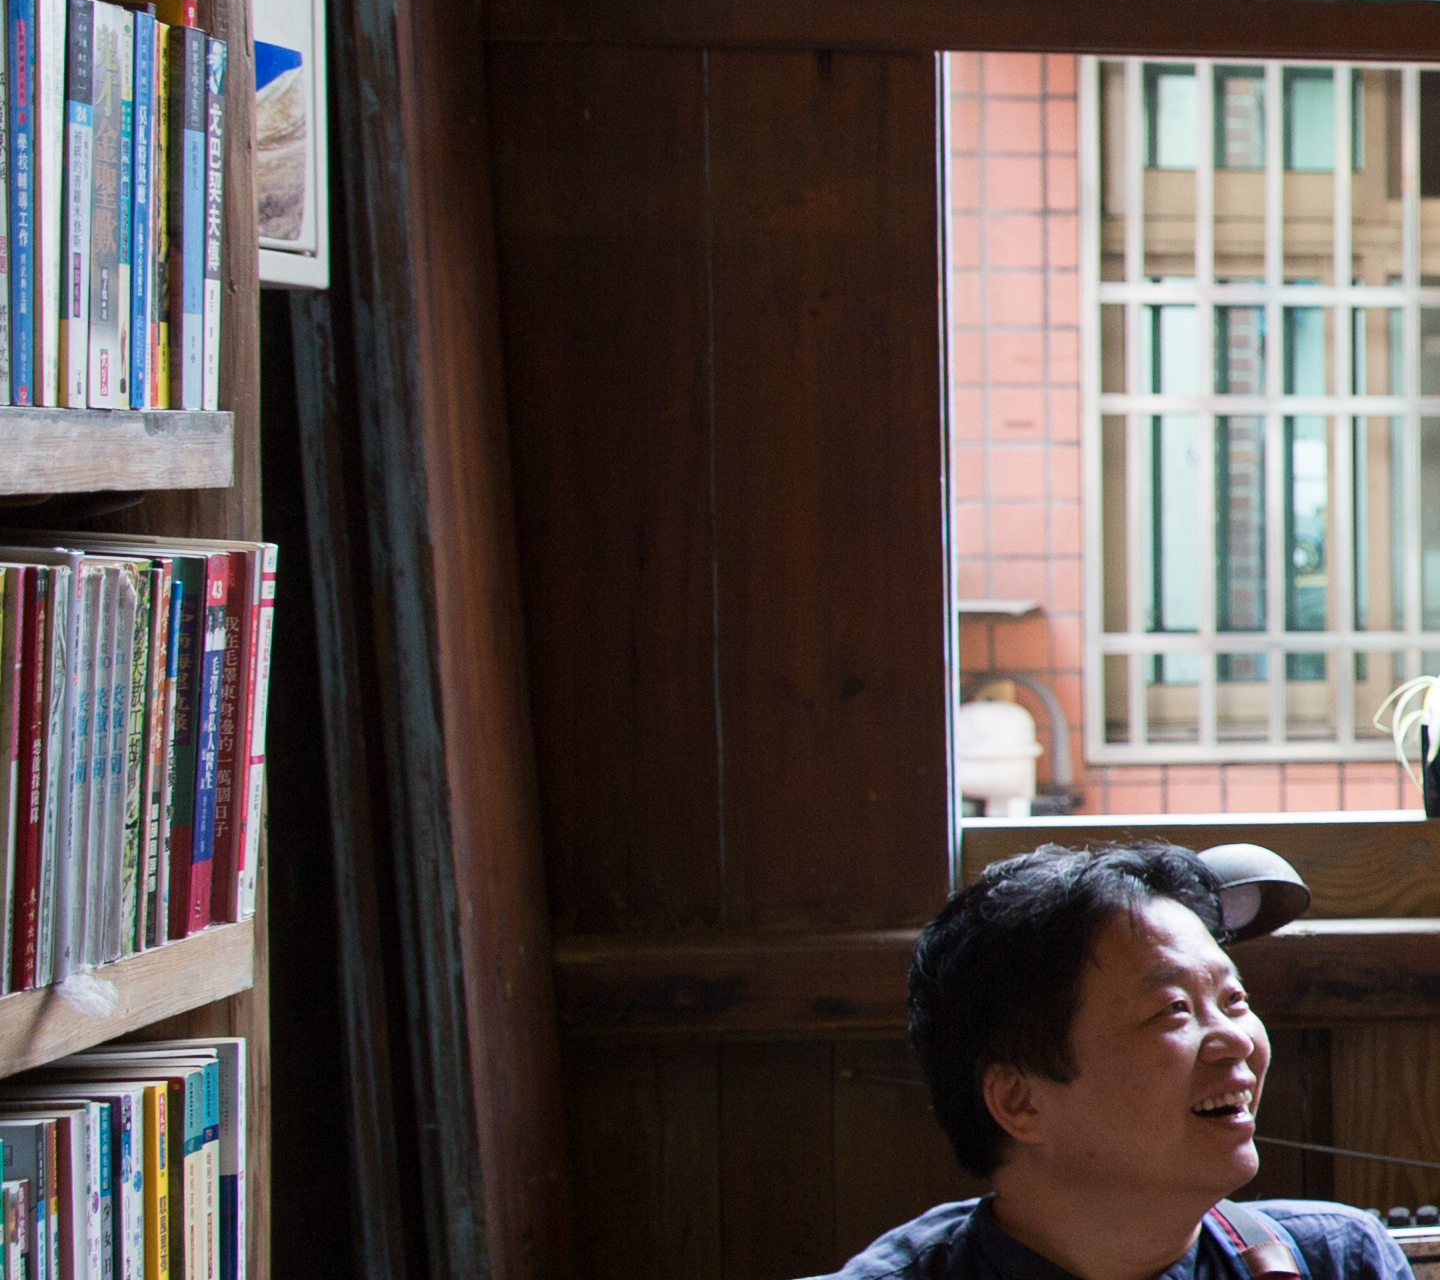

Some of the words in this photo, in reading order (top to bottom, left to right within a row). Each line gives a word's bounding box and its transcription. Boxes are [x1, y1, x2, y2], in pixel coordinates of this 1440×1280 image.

[76, 106, 87, 123] 24
[16, 132, 29, 247] 學校輔導工作
[206, 103, 224, 270] 戈巴契夫傳
[212, 580, 222, 599] 43
[214, 616, 239, 838] 我在毛澤東身邊的一萬個日子
